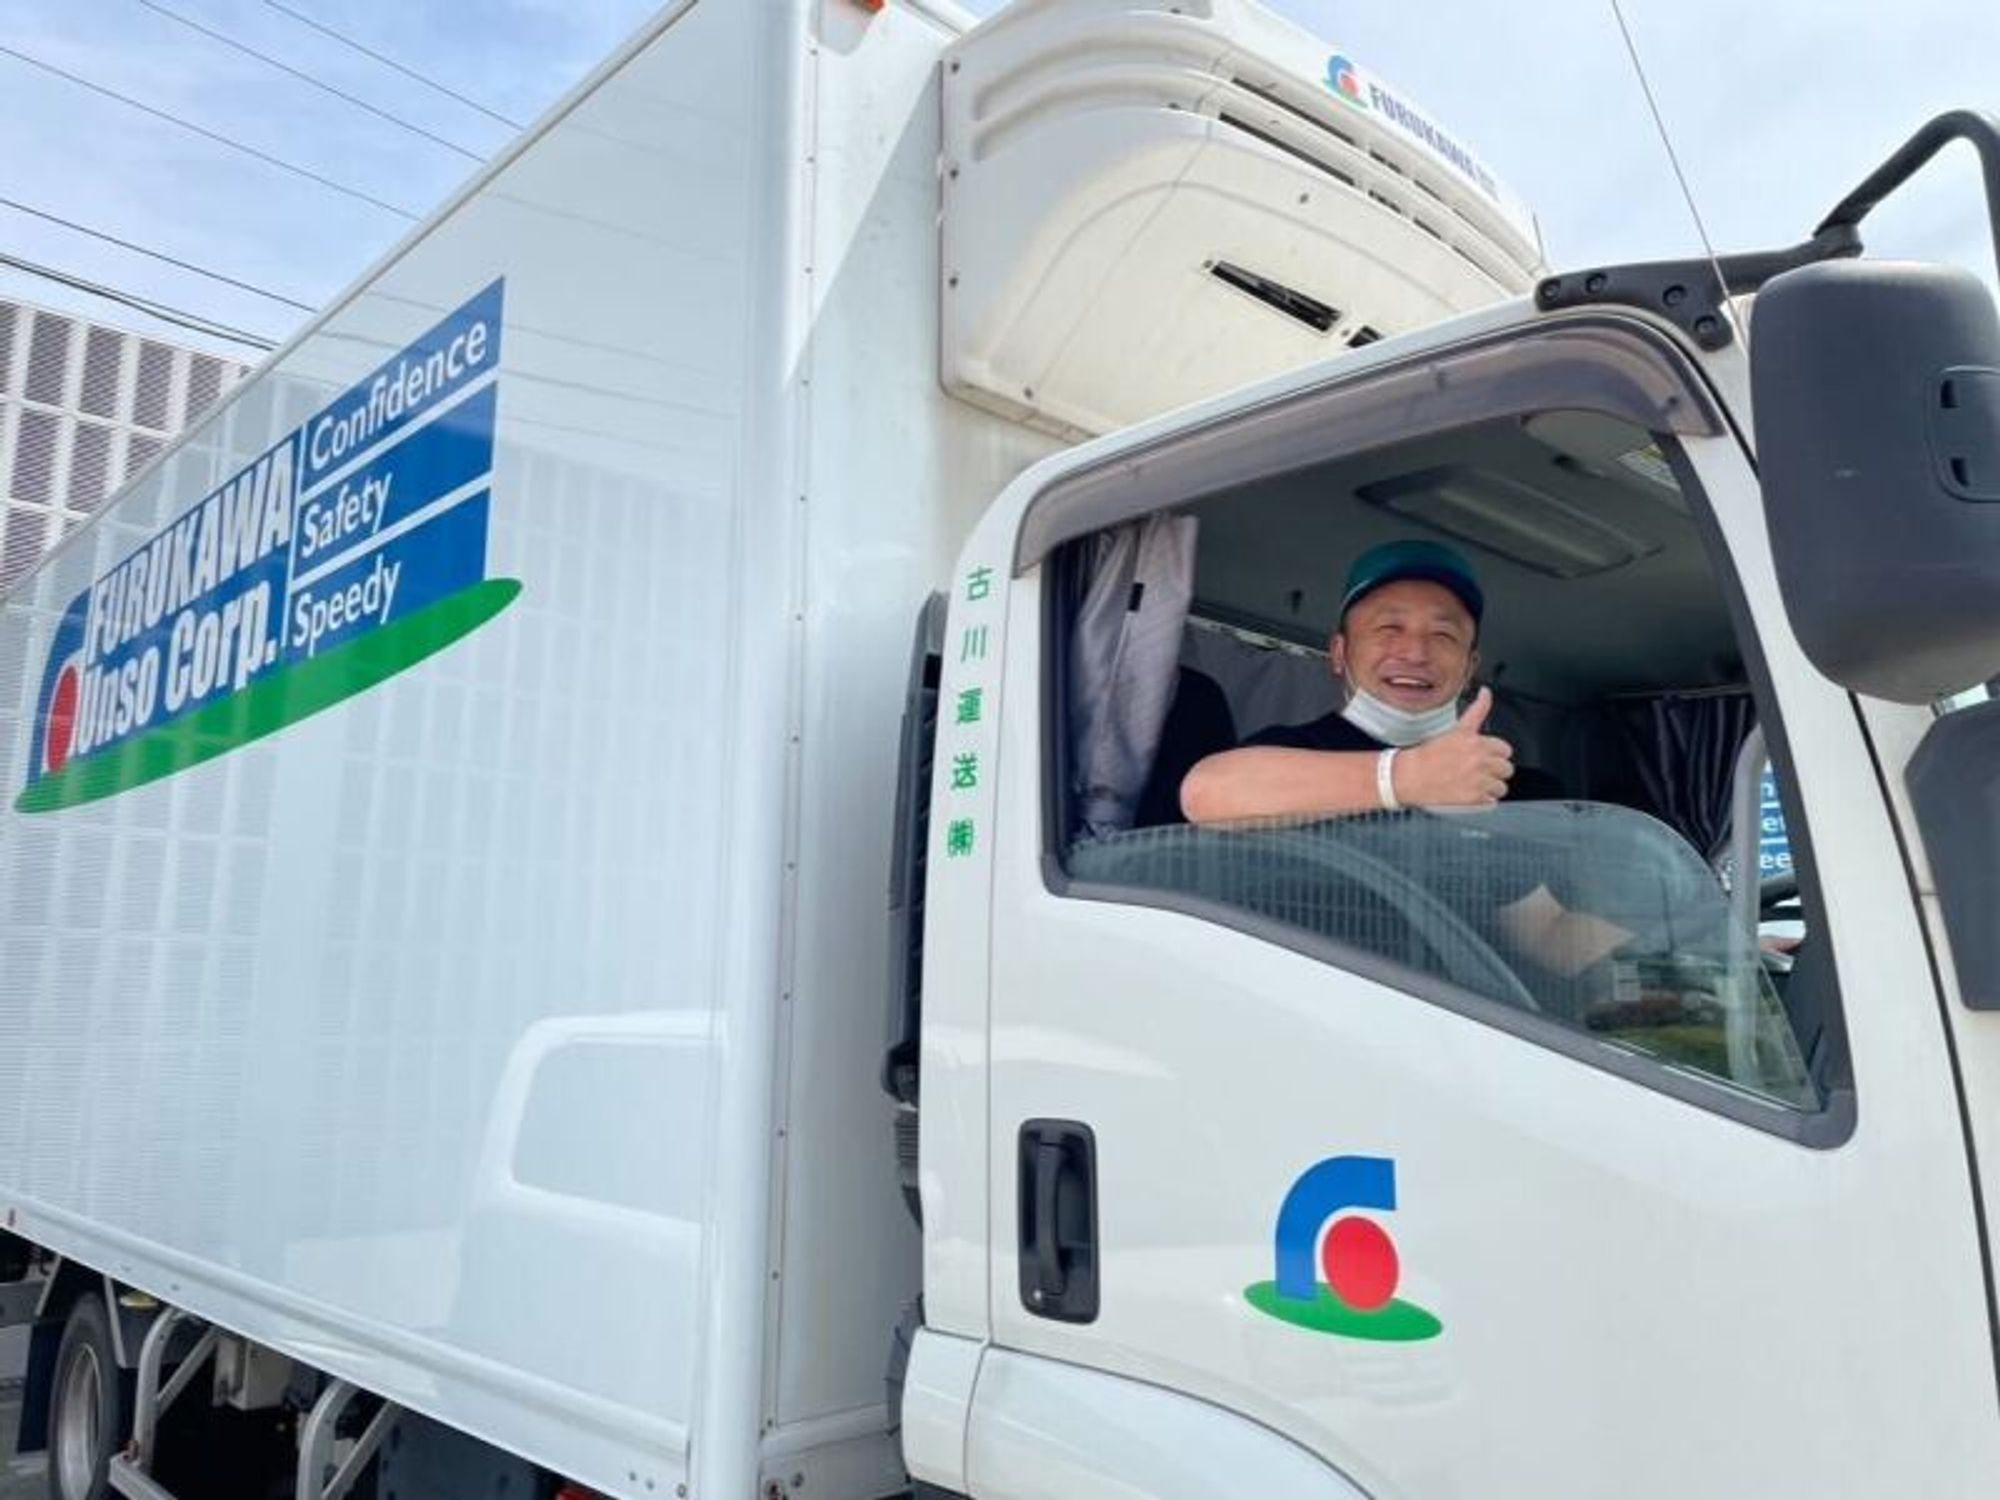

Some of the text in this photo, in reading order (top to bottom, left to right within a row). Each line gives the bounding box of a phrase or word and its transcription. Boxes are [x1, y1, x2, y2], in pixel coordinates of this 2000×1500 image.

[311, 321, 488, 471] Confidence
[88, 439, 294, 666] FURUKAWA
[302, 473, 393, 558] Safety
[79, 580, 276, 755] Unso Corp.
[293, 554, 401, 658] Speedy
